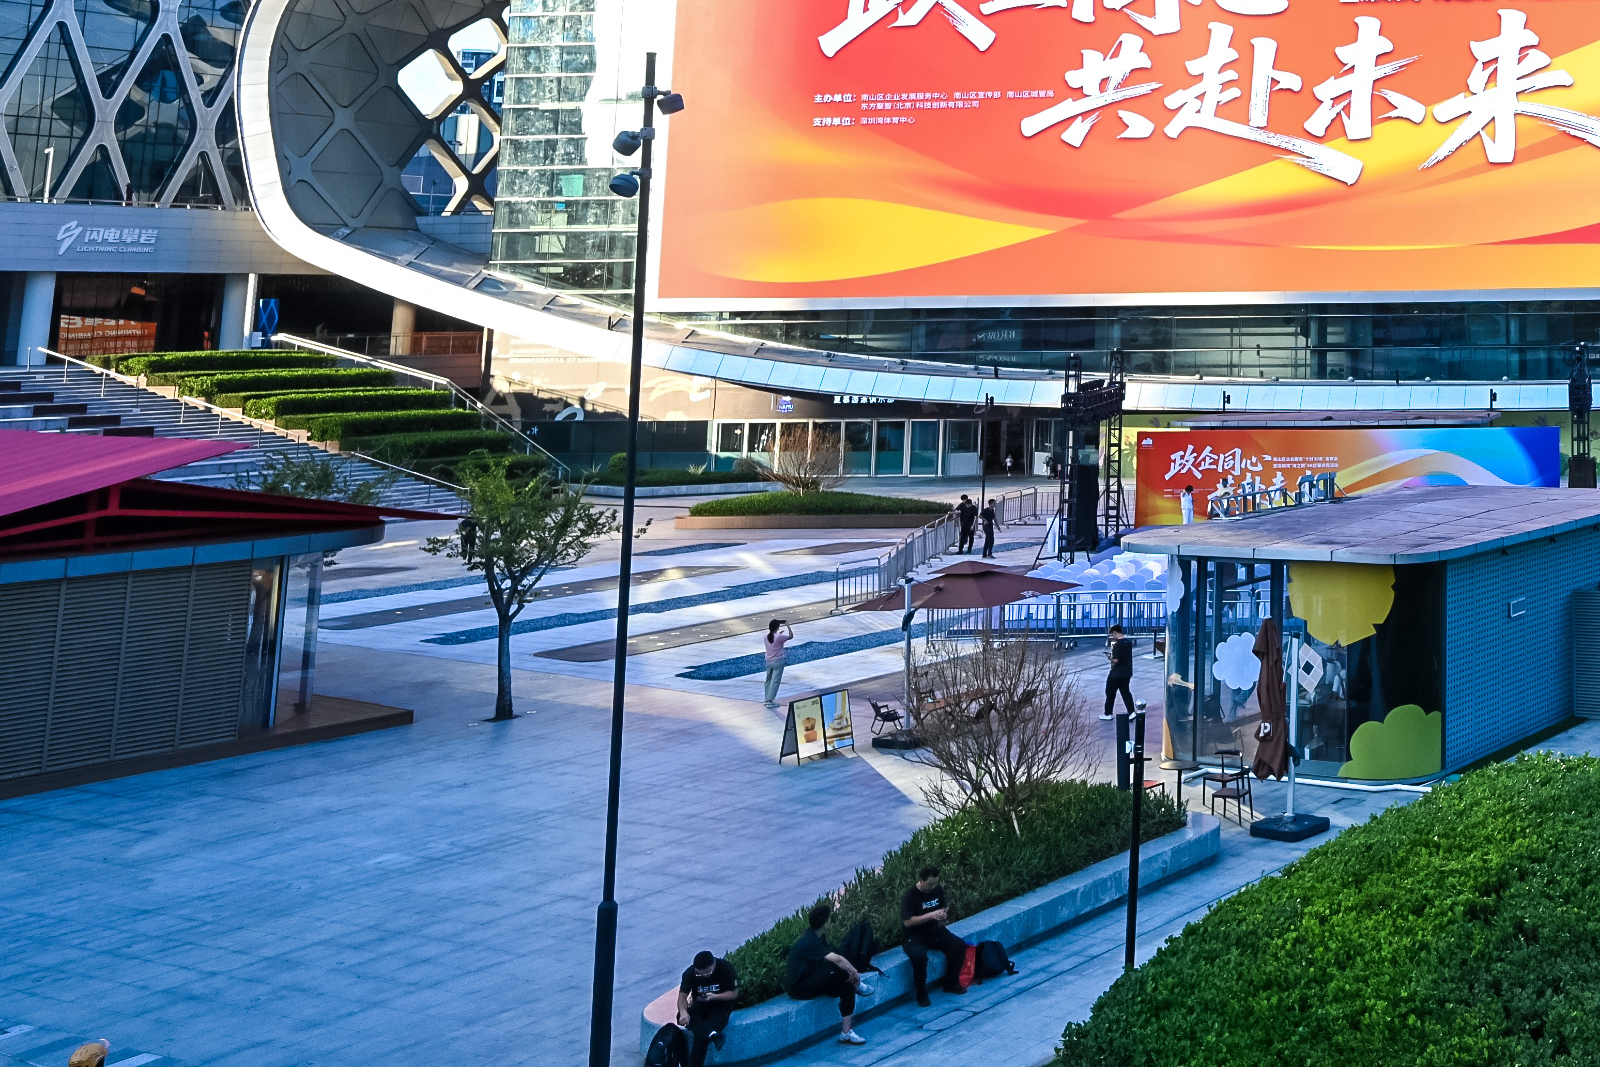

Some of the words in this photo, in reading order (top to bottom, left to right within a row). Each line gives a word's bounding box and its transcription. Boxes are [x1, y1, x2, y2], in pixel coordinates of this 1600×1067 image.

[84, 228, 158, 243] 闪电攀岩
[1164, 444, 1271, 480] 政企同心
